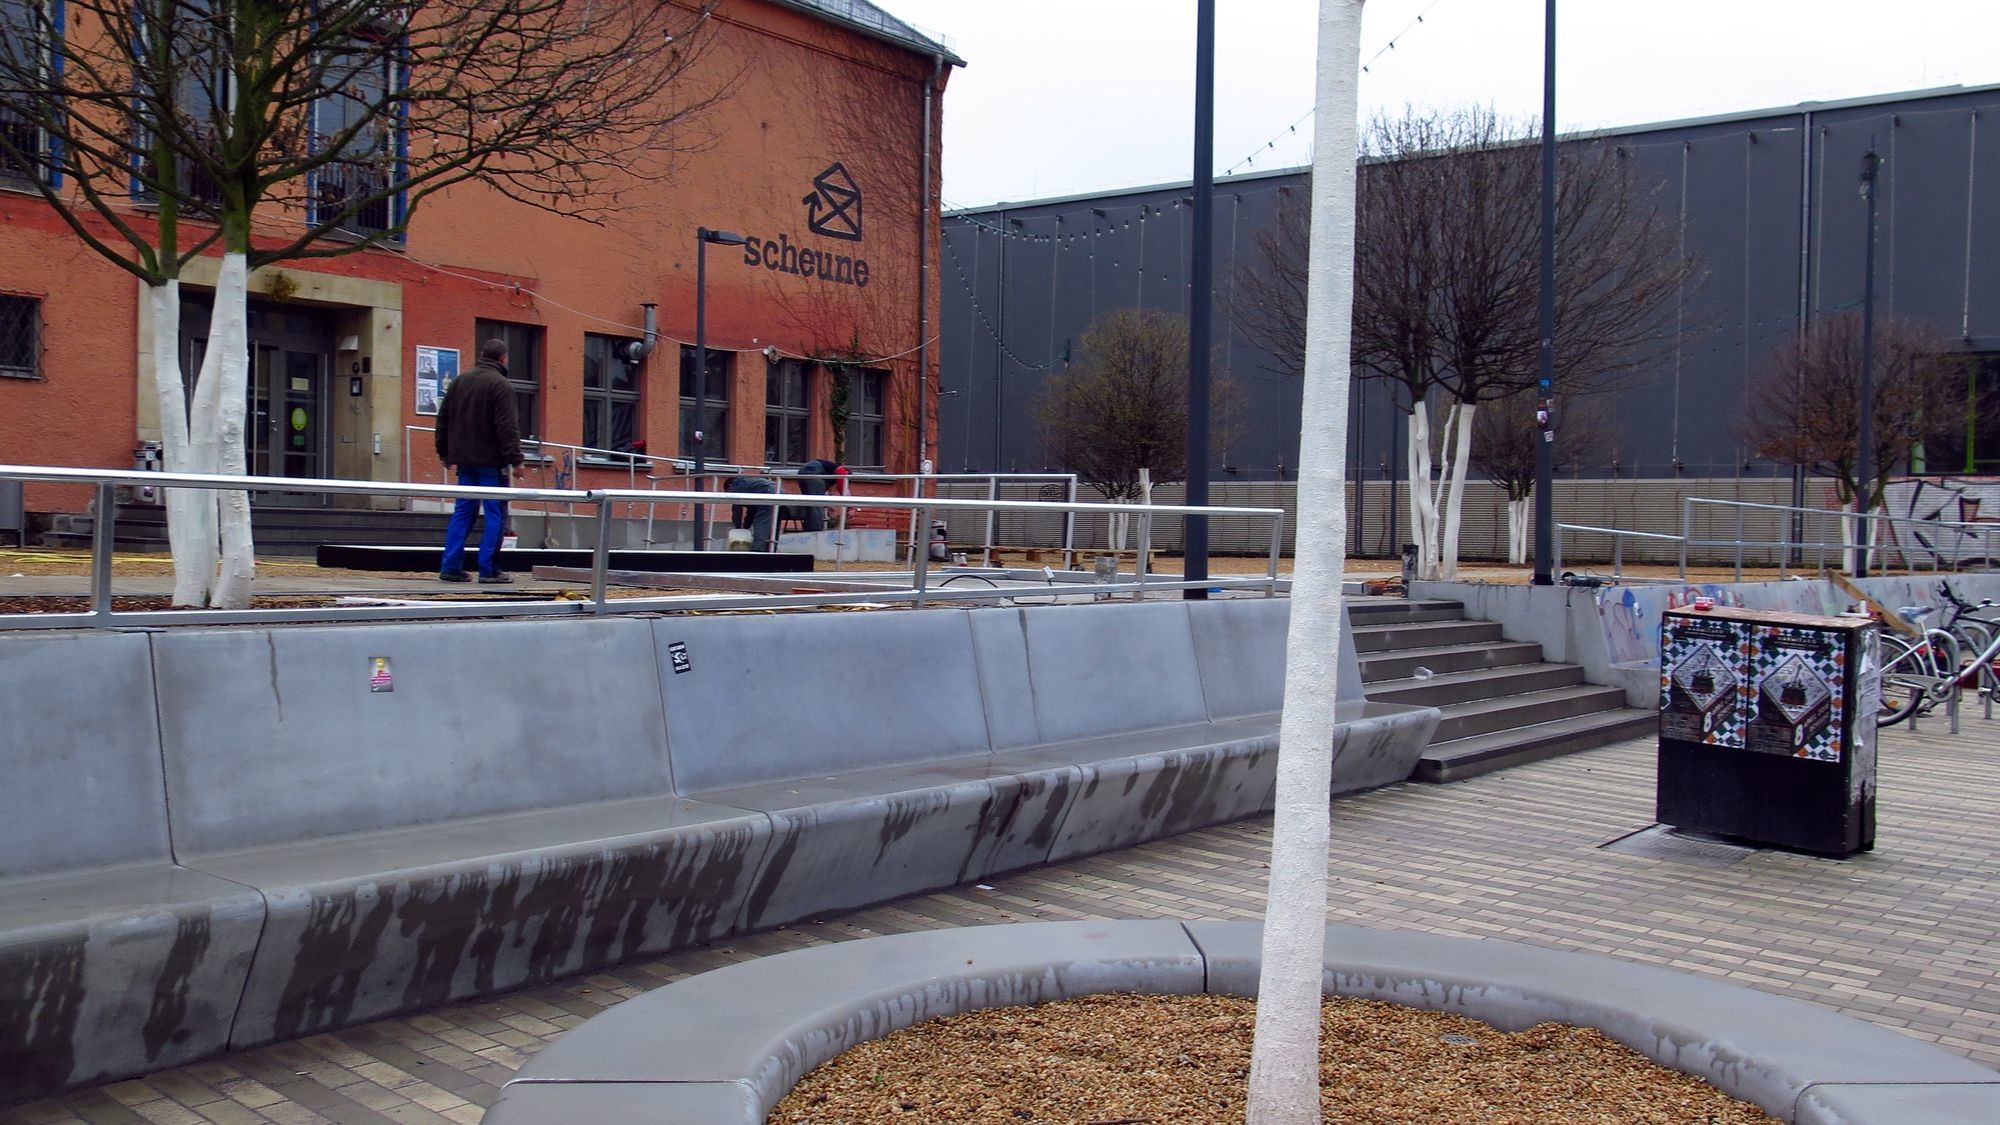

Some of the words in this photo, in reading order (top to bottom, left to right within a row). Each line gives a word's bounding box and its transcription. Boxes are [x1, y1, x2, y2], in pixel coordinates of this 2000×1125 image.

[744, 233, 869, 288] scheune
[1703, 711, 1712, 733] 8
[1794, 724, 1804, 746] 8
